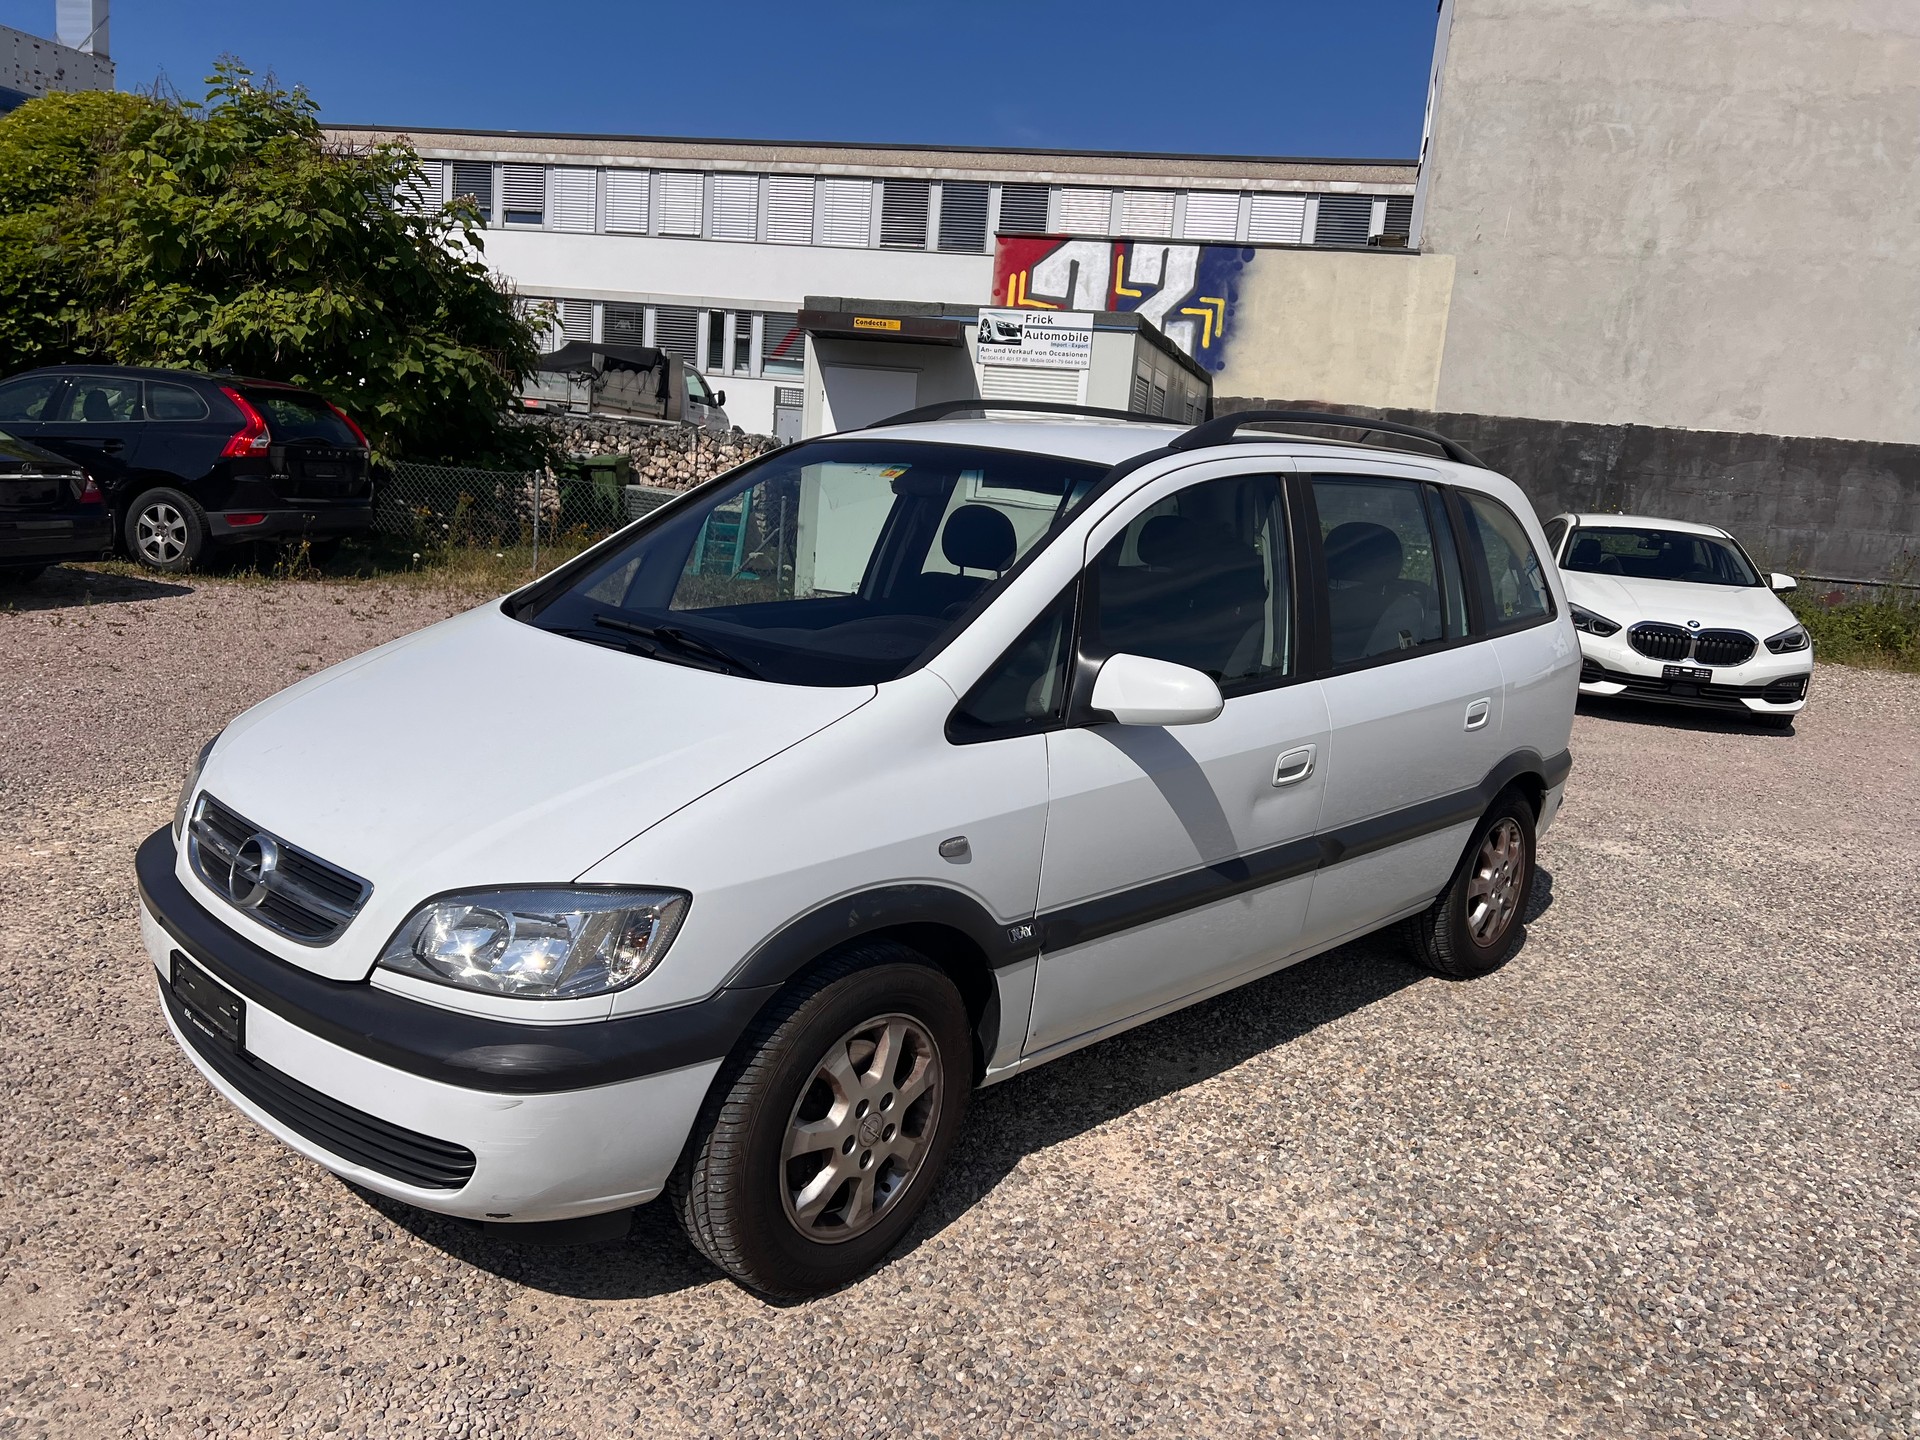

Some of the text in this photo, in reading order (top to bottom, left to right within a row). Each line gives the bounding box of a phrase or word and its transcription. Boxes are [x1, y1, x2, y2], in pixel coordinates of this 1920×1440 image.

[1025, 314, 1054, 325] Frick
[1024, 330, 1088, 342] Automobile
[1048, 350, 1088, 358] Occasionen
